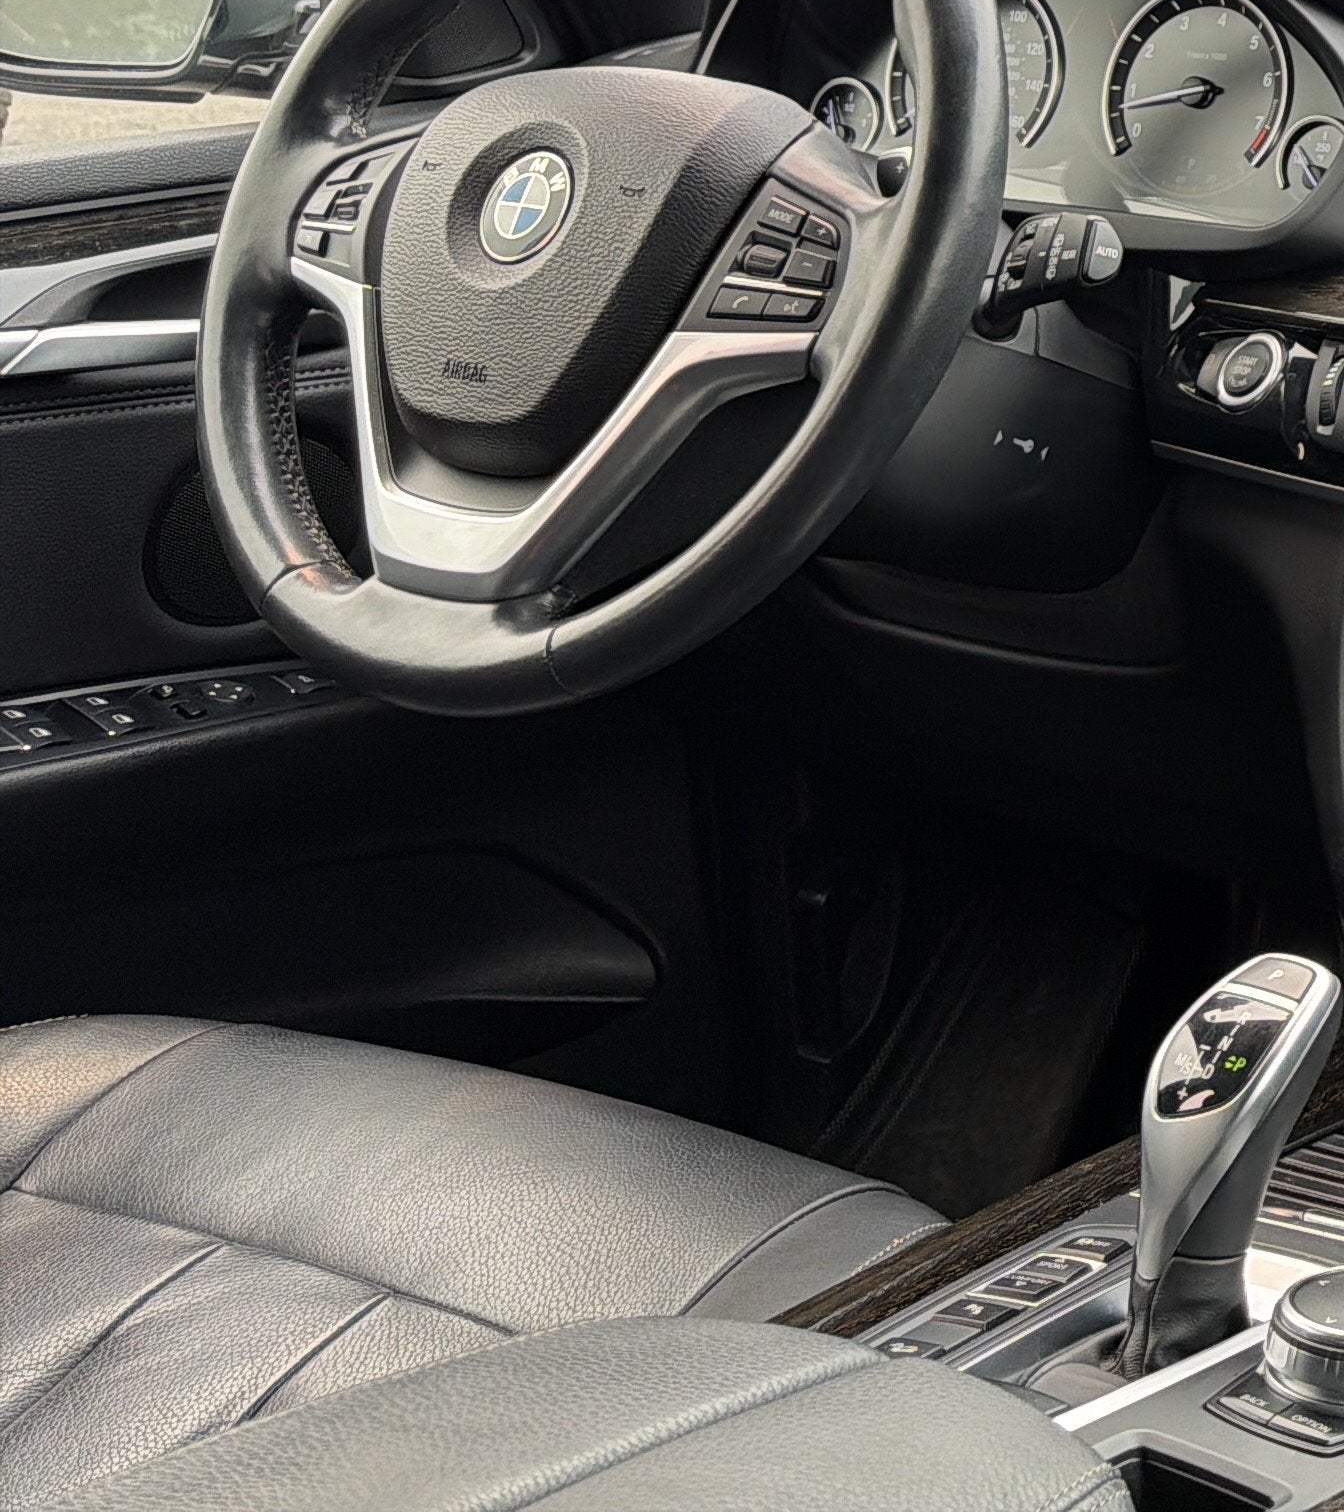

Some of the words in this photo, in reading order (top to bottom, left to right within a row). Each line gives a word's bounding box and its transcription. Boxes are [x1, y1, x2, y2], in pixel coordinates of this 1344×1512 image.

[1009, 10, 1028, 23] 100
[1180, 16, 1190, 31] 3
[1217, 12, 1228, 28] 4
[1026, 42, 1045, 56] 120
[1249, 35, 1259, 50] 5
[1143, 43, 1155, 58] 2
[1025, 79, 1043, 92] 140
[1263, 71, 1273, 88] 6
[1130, 83, 1137, 98] 1
[1132, 122, 1142, 138] 0
[1255, 115, 1265, 130] 7
[502, 157, 566, 192] BMW
[768, 208, 794, 224] MODE
[1096, 246, 1119, 259] AUTO
[442, 359, 488, 384] AIRBAG
[1267, 969, 1285, 980] P
[1217, 1035, 1234, 1051] N
[1201, 1063, 1215, 1079] D
[1232, 1057, 1247, 1072] P
[1239, 1393, 1269, 1408] BACK
[1291, 1414, 1333, 1433] OPTION
